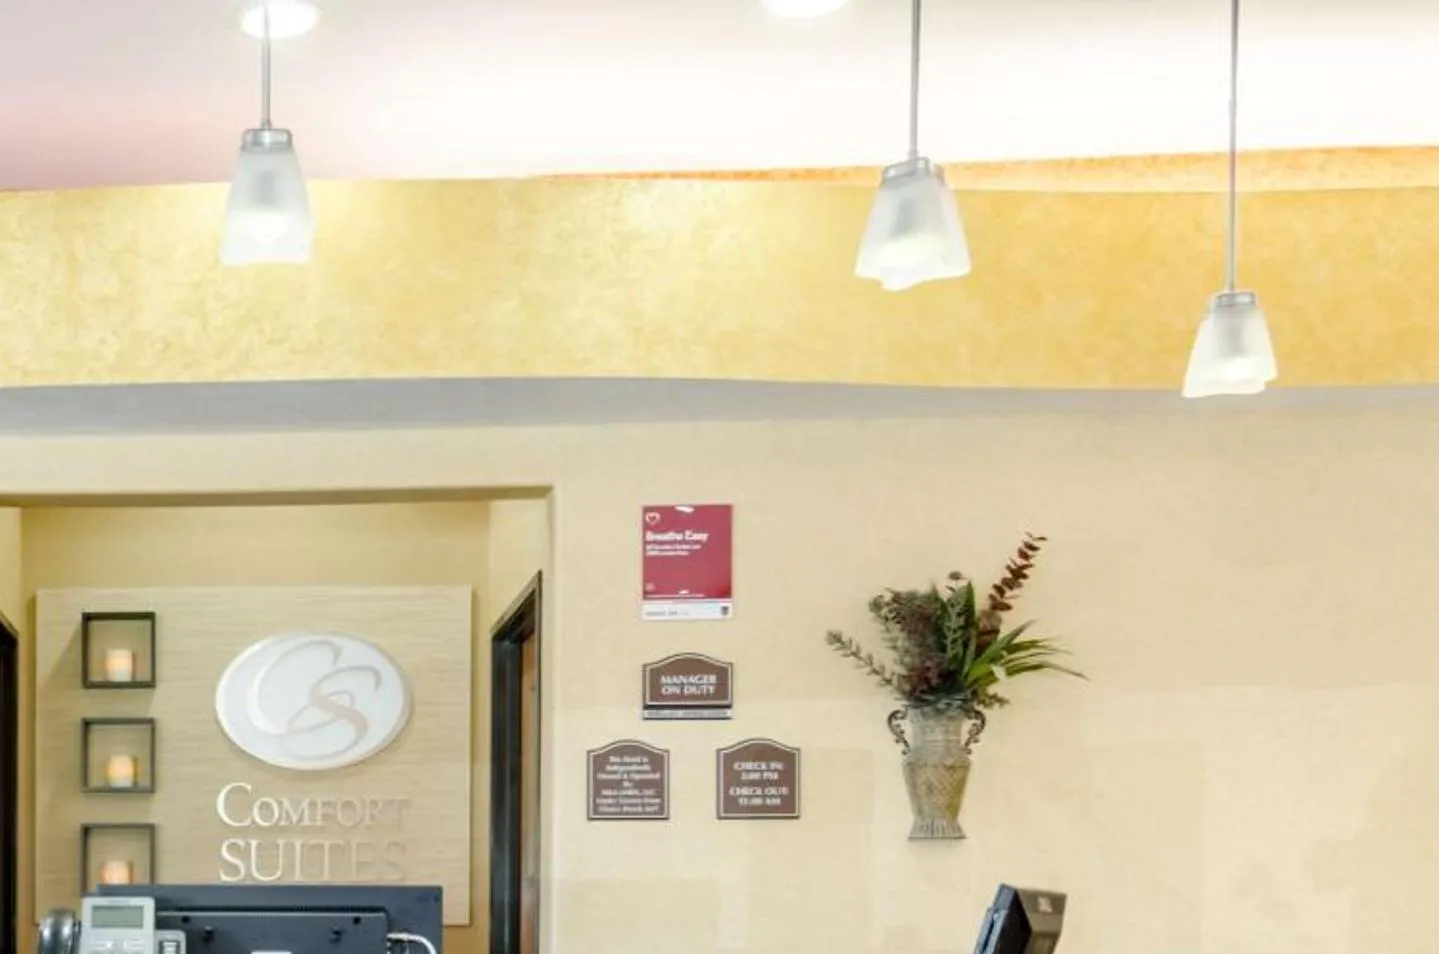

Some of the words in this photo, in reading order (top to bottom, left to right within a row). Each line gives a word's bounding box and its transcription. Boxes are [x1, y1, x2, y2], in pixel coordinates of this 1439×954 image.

[660, 675, 716, 684] MANAGER
[661, 686, 680, 695] ON
[684, 686, 715, 695] DUTY
[733, 762, 767, 770] CHECK
[729, 787, 763, 795] CHECK
[216, 782, 411, 827] COMFORT
[219, 838, 407, 881] SUITES
